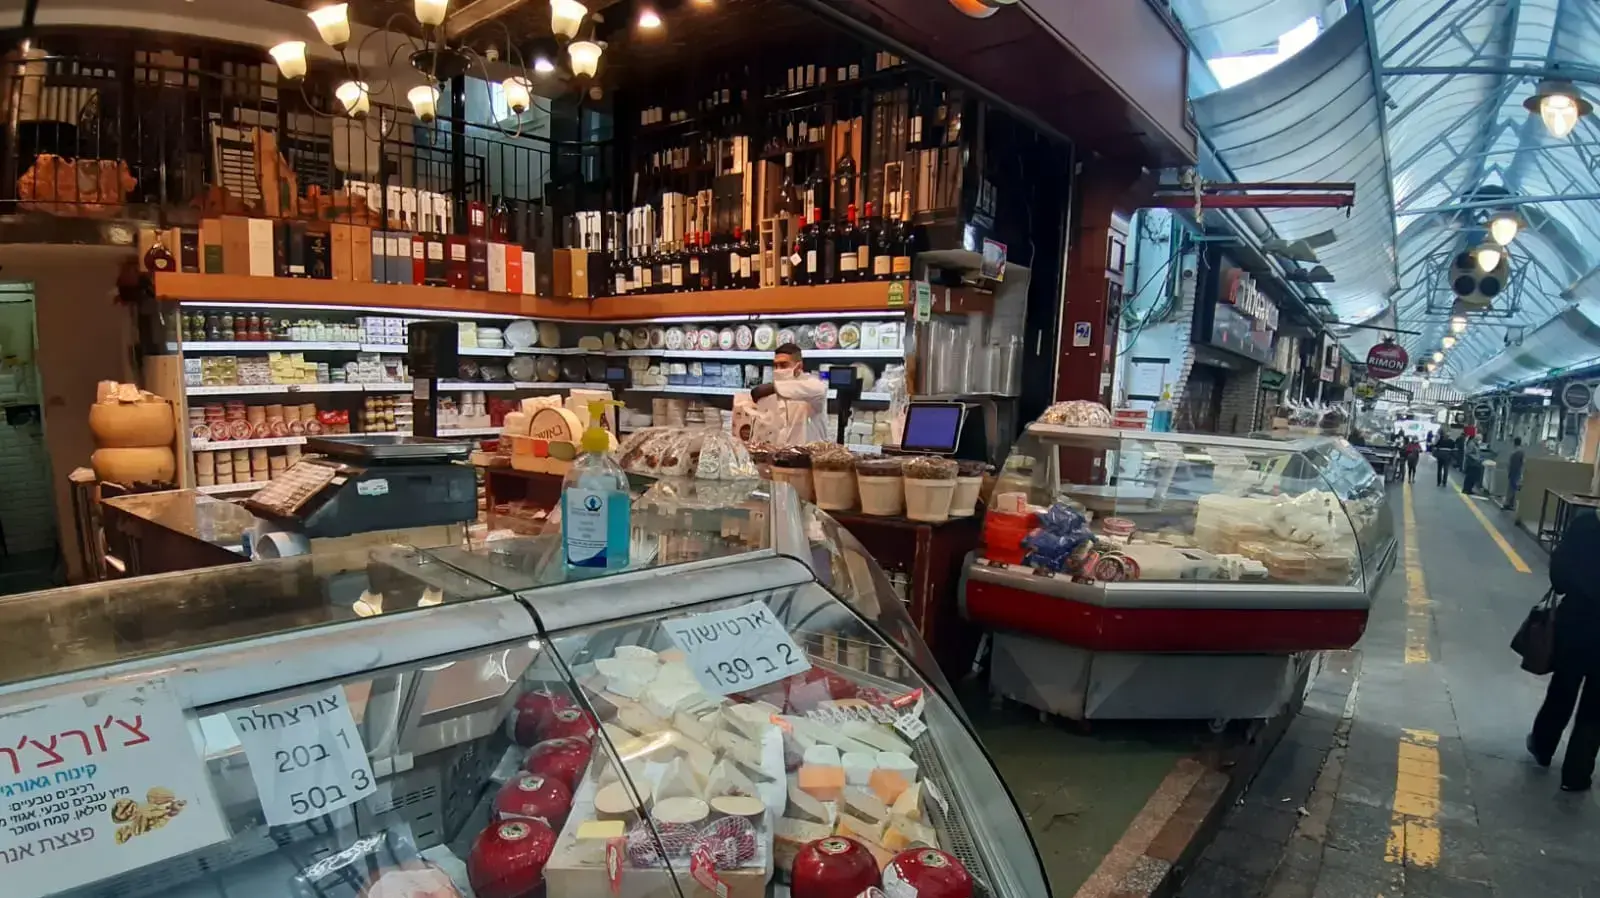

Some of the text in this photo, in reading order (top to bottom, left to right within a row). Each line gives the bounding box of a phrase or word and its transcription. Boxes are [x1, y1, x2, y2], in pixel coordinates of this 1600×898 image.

[1369, 357, 1404, 369] RIMON
[676, 610, 772, 653] ארטישוק
[705, 643, 799, 687] 2 ב 139
[237, 694, 339, 732] צורצחלה
[275, 728, 350, 773] 1 ב20
[0, 764, 97, 797] קינוח גאורגי
[110, 786, 130, 799] מיץ
[290, 769, 370, 815] 3 ב50
[9, 783, 95, 811] רכיבים טבעיים:
[73, 792, 106, 807] ענבים
[9, 821, 41, 836] וסוכר
[10, 810, 35, 825] אגוזי
[43, 813, 70, 827] קמח
[38, 827, 95, 854] פצצת
